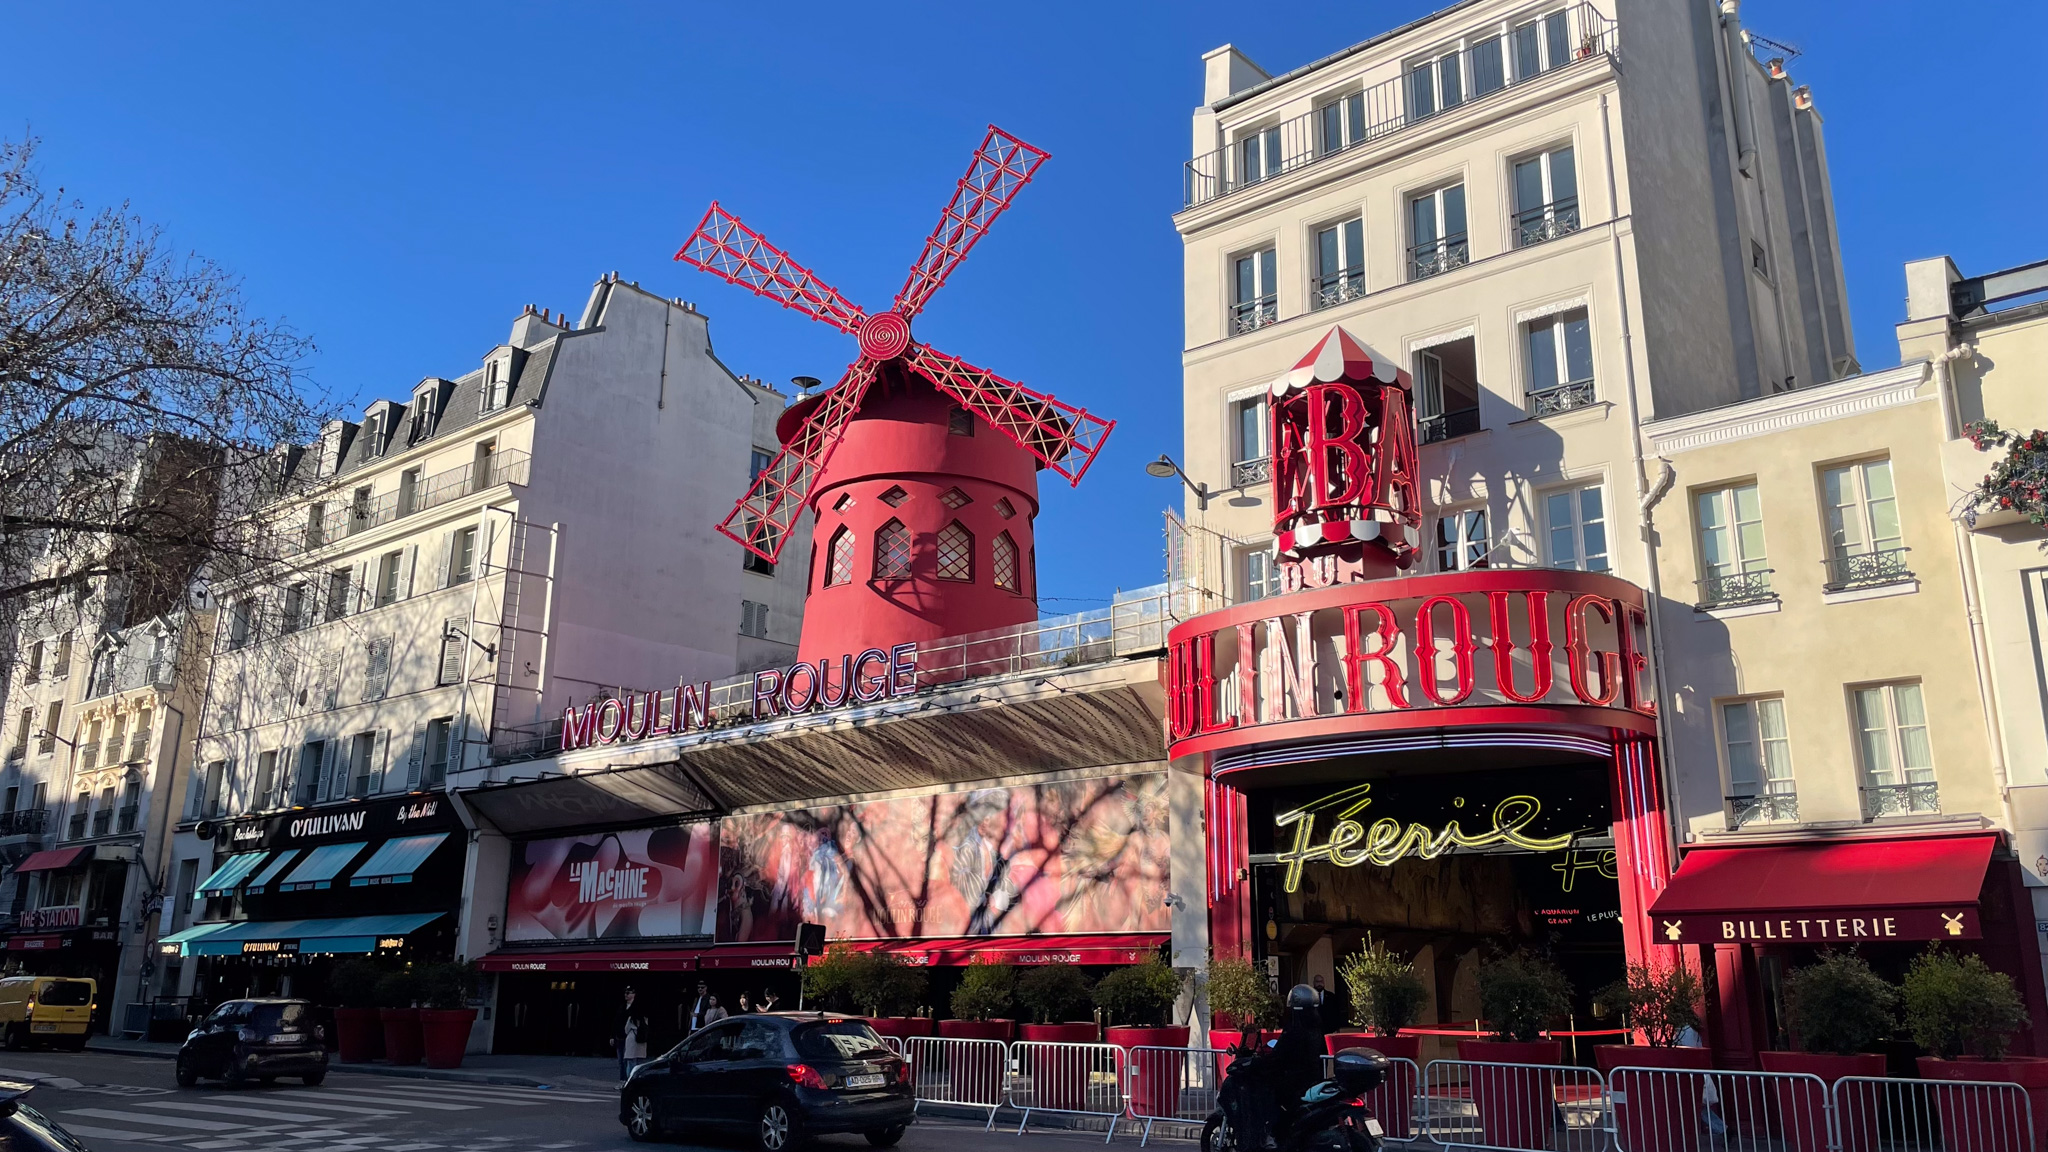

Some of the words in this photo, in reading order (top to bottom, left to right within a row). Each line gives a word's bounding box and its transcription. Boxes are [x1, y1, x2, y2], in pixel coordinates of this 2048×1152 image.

[1280, 553, 1337, 594] DU
[1342, 592, 1657, 718] ROUGE
[560, 680, 711, 751] MOULIN
[752, 641, 917, 720] ROUGE
[396, 805, 407, 825] By
[407, 803, 421, 819] the
[420, 800, 439, 818] Mill
[290, 810, 367, 838] O'SULLIVANS
[1275, 783, 1574, 893] Féerie
[570, 862, 580, 877] LA
[579, 860, 649, 903] MACHINE
[20, 911, 35, 928] THE
[39, 908, 77, 927] STATION
[908, 905, 942, 924] ROUGE
[1598, 910, 1619, 920] PLUS
[93, 932, 114, 940] BAR
[1721, 917, 1897, 939] BILLETTERIE
[243, 942, 280, 952] O'SULLIVANS
[1019, 954, 1050, 963] MOULIN
[1052, 954, 1081, 962] ROUGE
